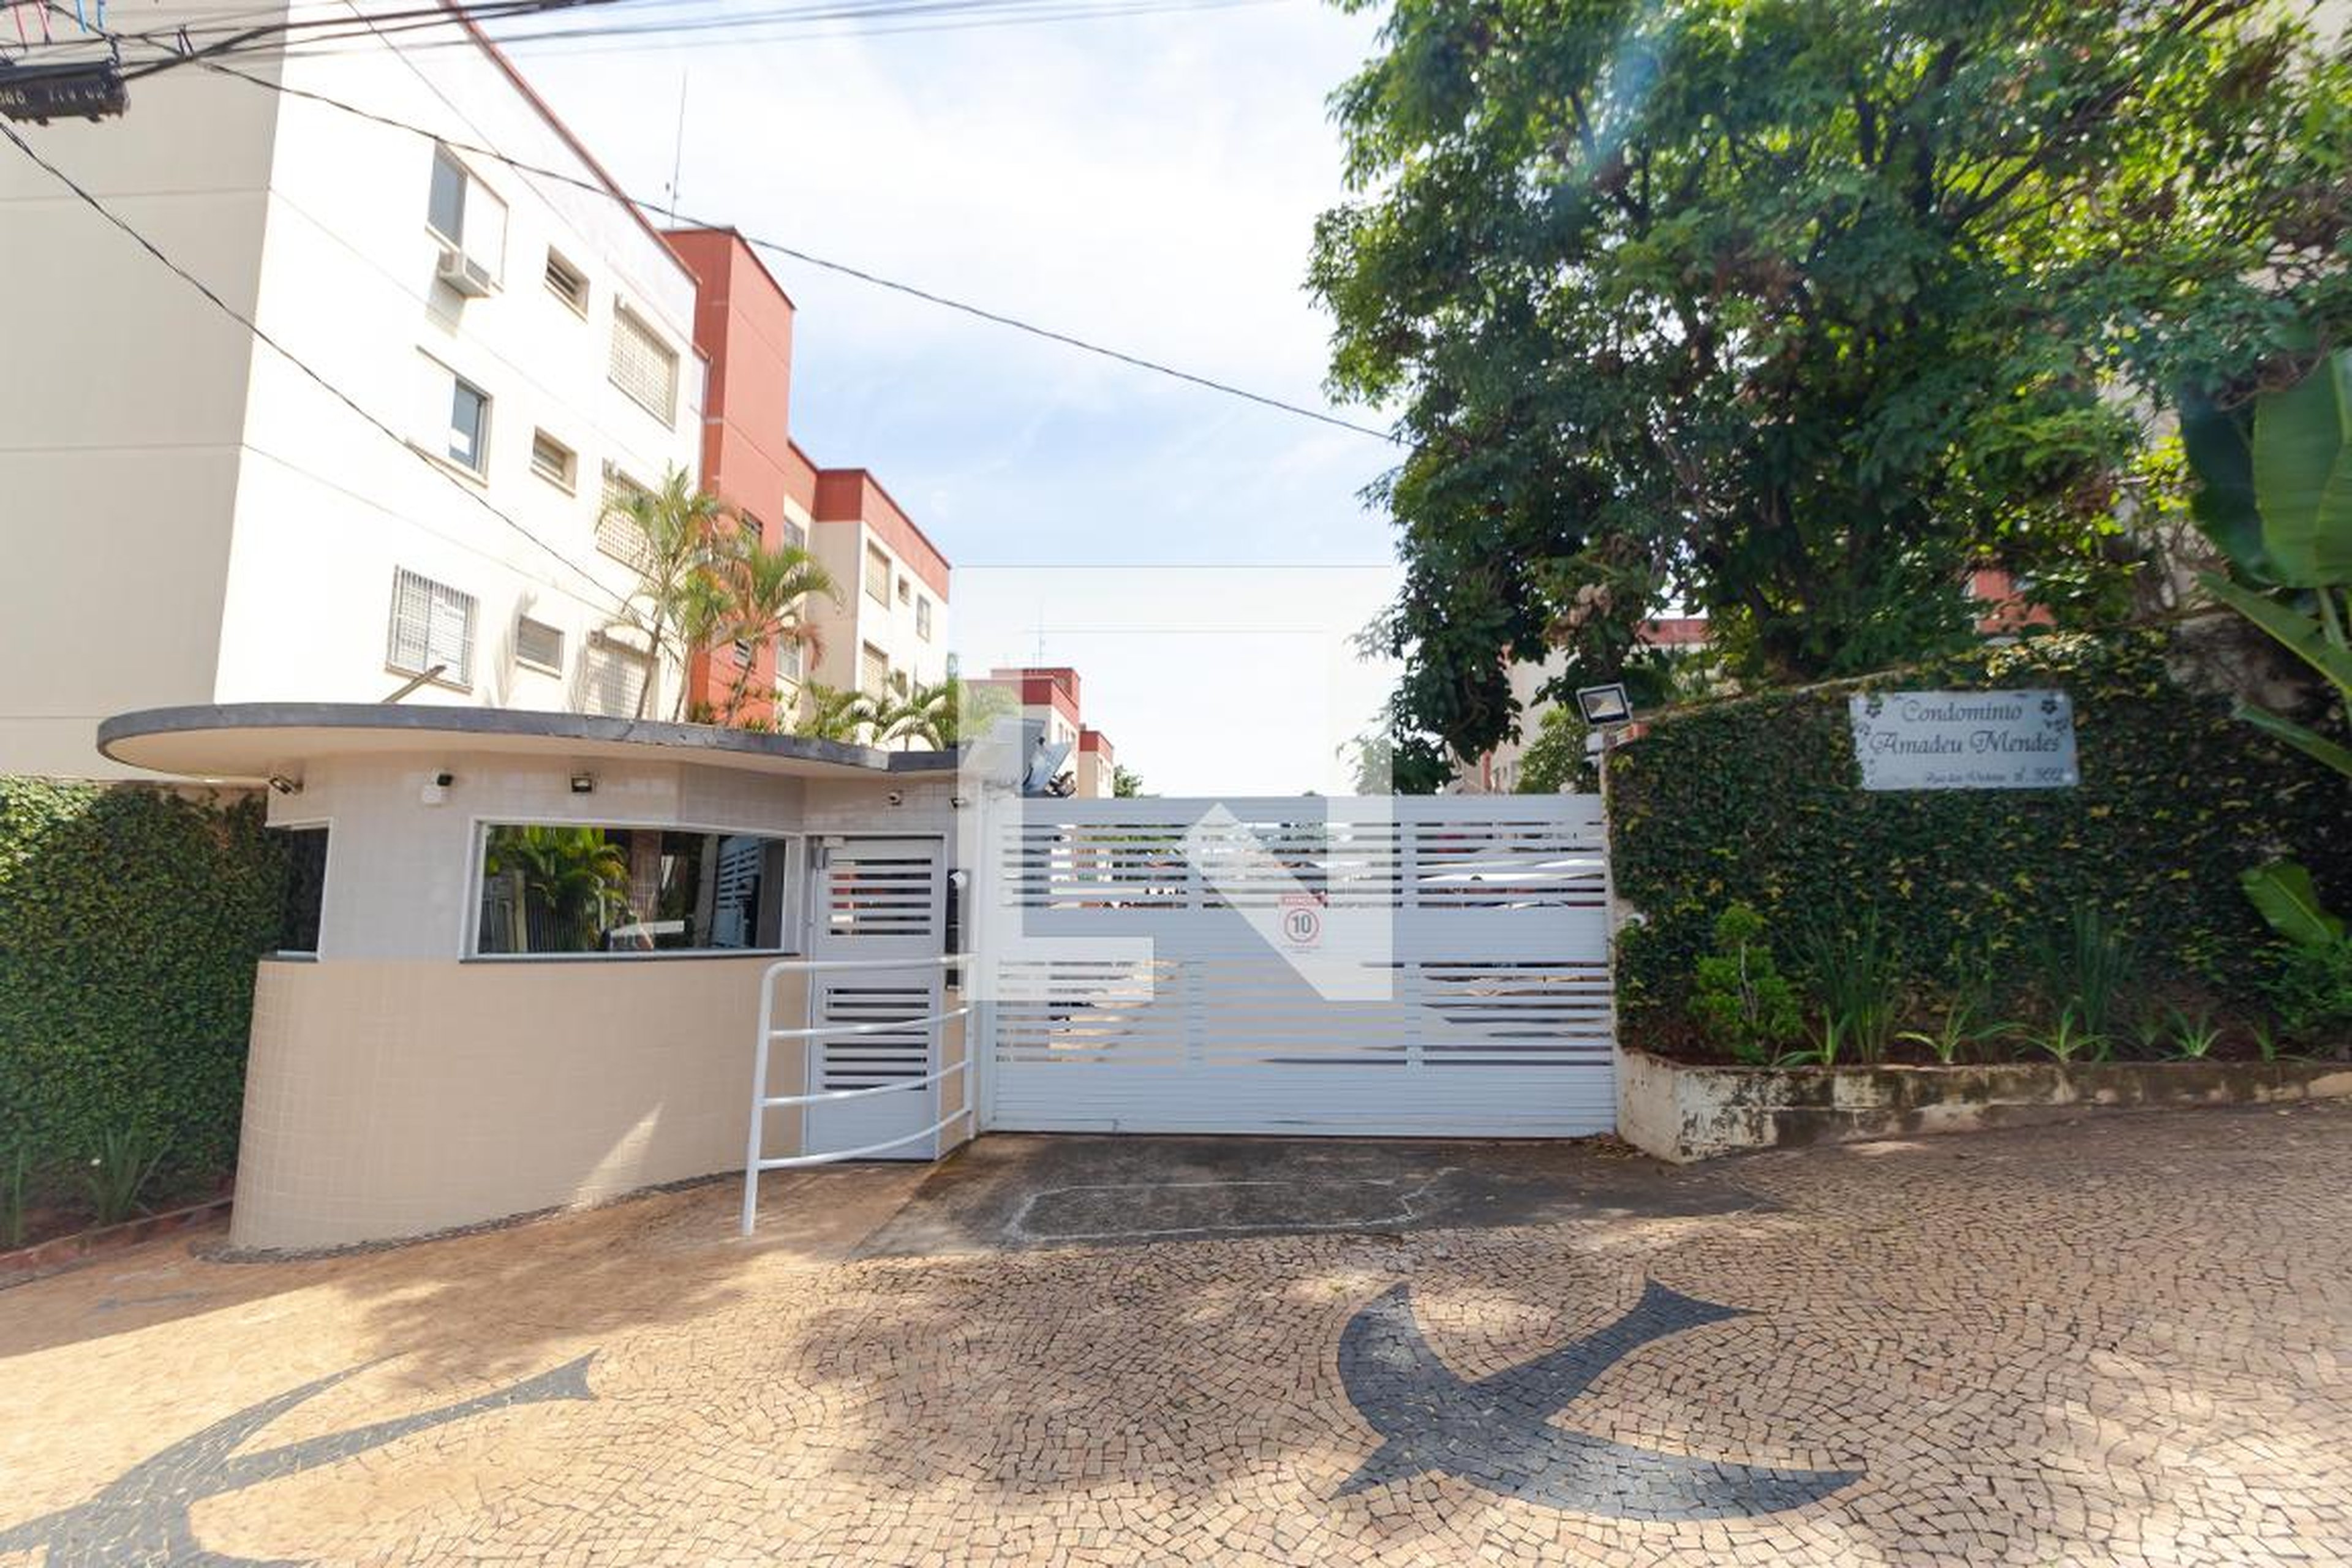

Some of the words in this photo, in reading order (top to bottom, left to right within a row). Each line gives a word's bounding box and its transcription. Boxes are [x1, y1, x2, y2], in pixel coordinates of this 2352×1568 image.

[1869, 732, 1962, 755] Amadeu
[1970, 729, 2059, 753] Mendes
[1292, 914, 1312, 933] 10
